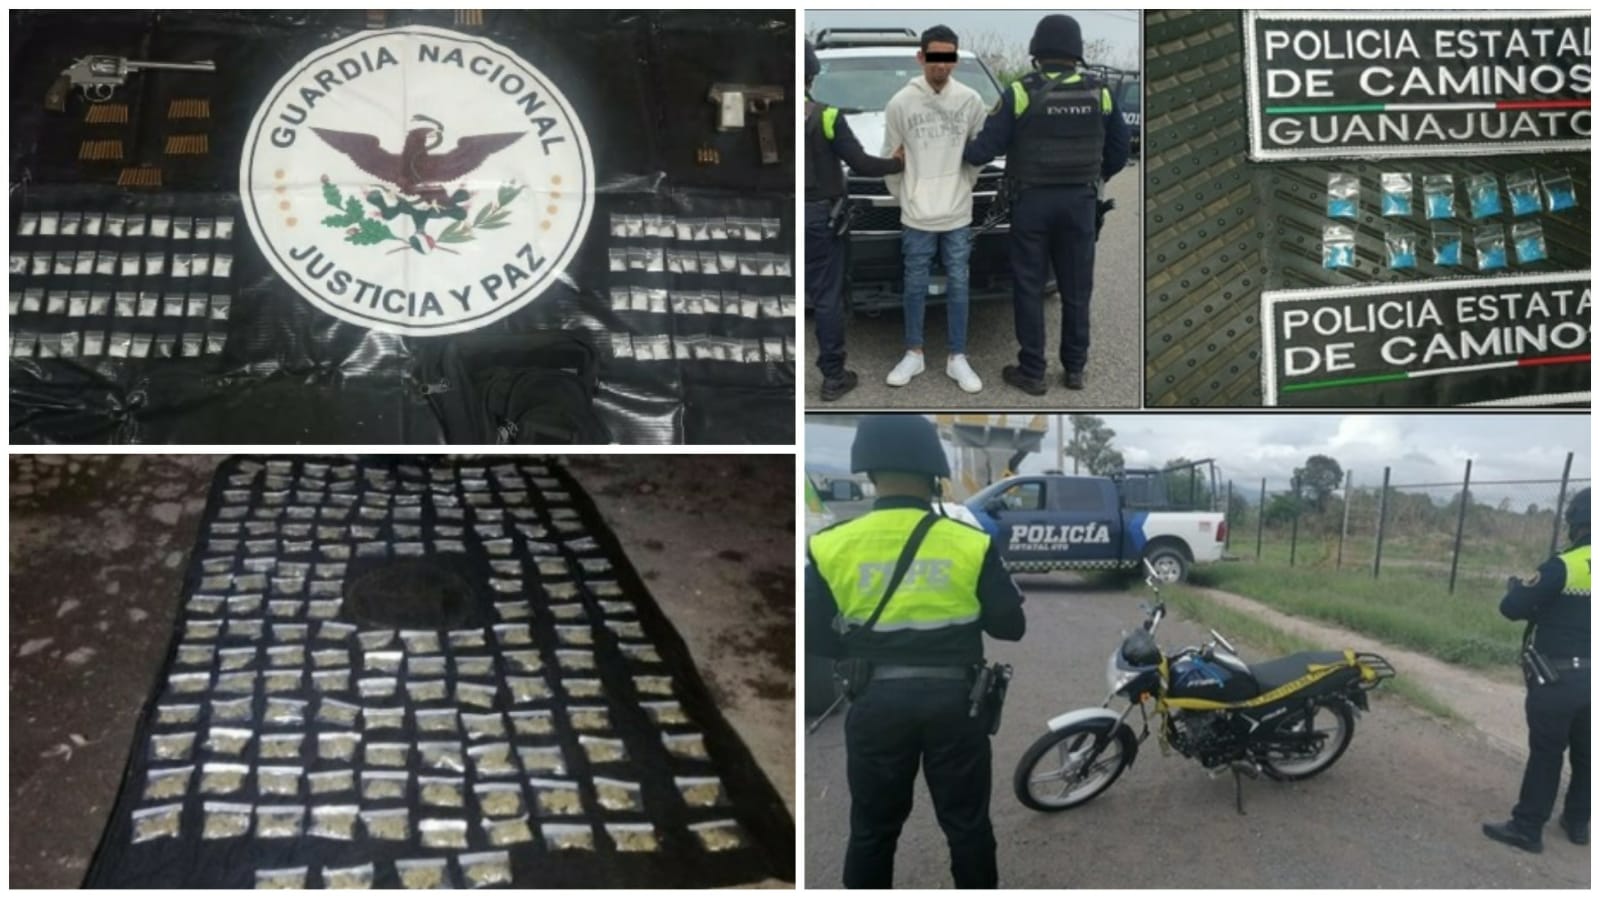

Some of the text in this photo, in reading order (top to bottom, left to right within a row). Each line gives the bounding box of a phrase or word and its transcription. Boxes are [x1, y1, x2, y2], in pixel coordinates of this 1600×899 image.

[1265, 29, 1421, 61] POLICIA
[271, 43, 566, 155] GUARDIA NACIONAL
[1265, 64, 1591, 99] DE CAMINOS
[289, 243, 546, 317] JUSTICIA Y PAZ
[1283, 300, 1443, 339] POLICIA
[1284, 321, 1591, 377] DE CAMINO
[1009, 521, 1110, 543] POLICÍA
